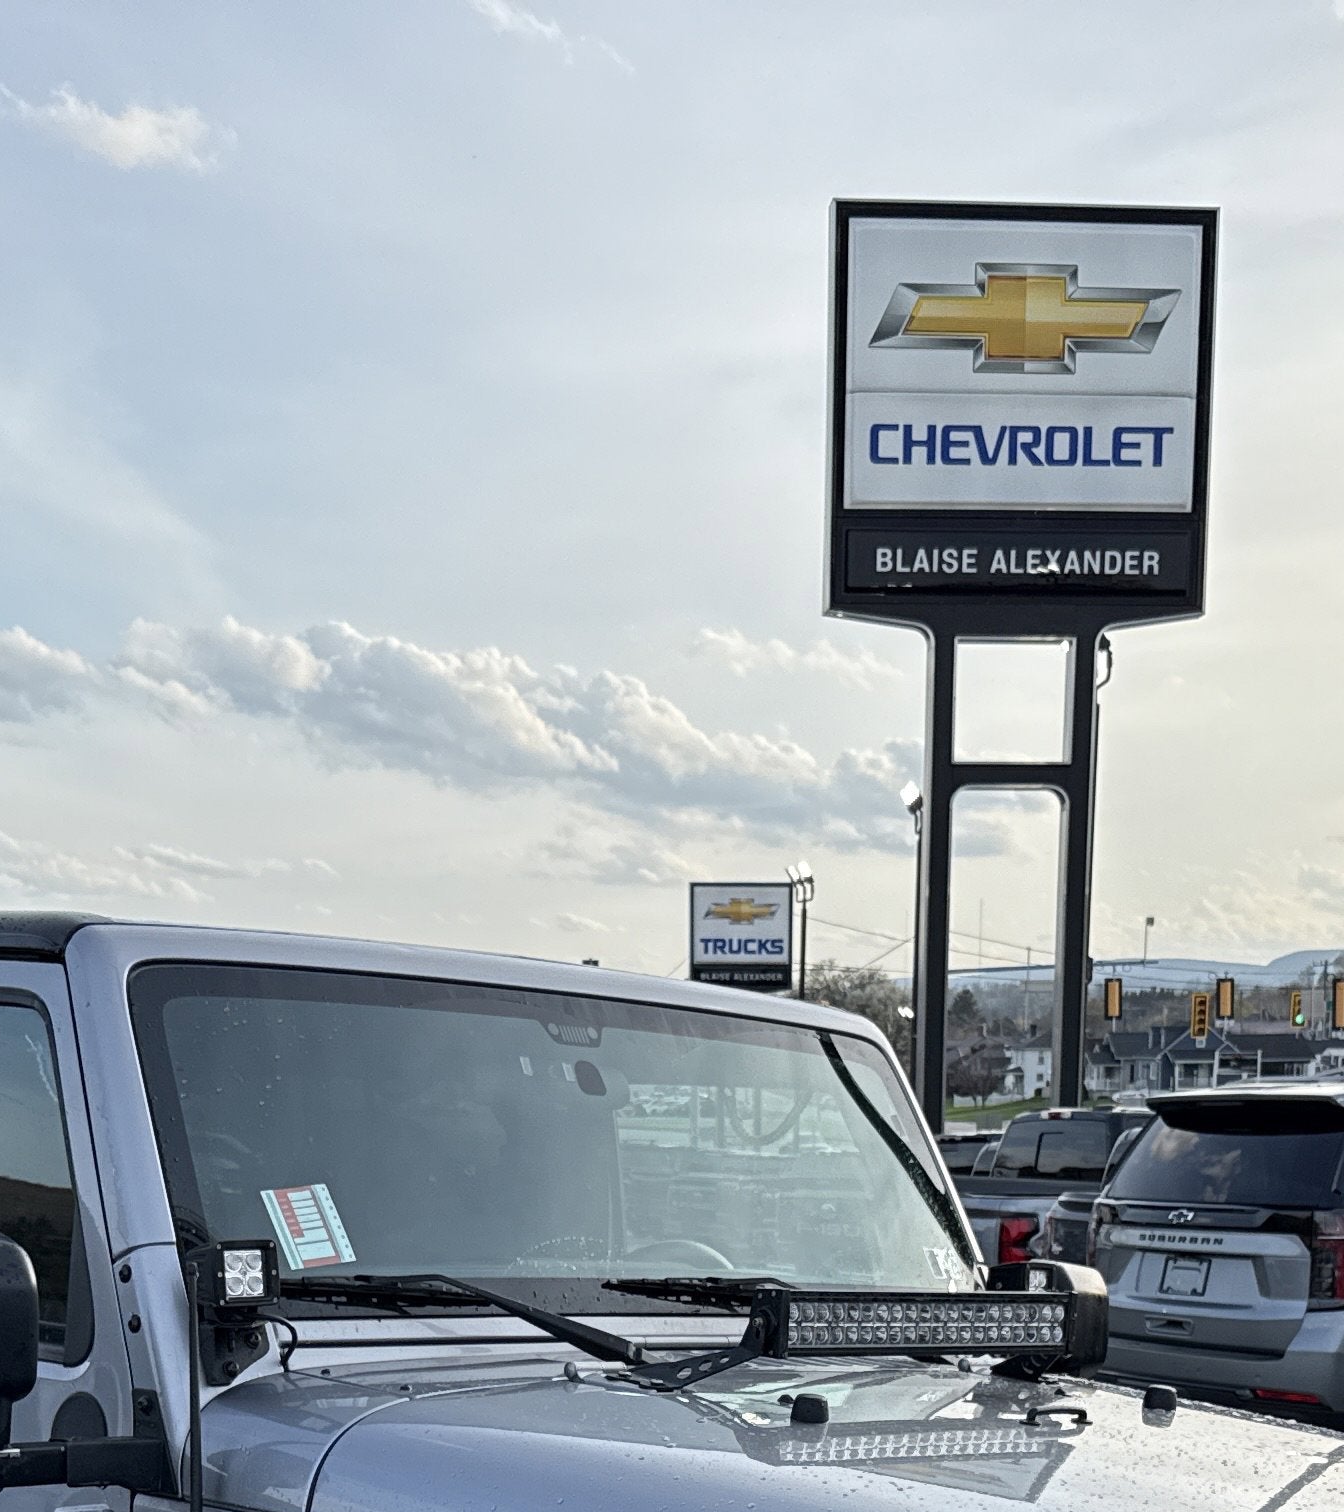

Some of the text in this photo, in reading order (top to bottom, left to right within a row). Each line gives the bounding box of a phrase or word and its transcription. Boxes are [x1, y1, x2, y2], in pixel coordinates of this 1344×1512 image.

[869, 423, 1174, 467] CHEVROLET
[875, 547, 1161, 576] BLAISE ALEXANDER
[700, 939, 784, 955] TRUCKS
[1139, 1233, 1224, 1246] SUBURBAN
